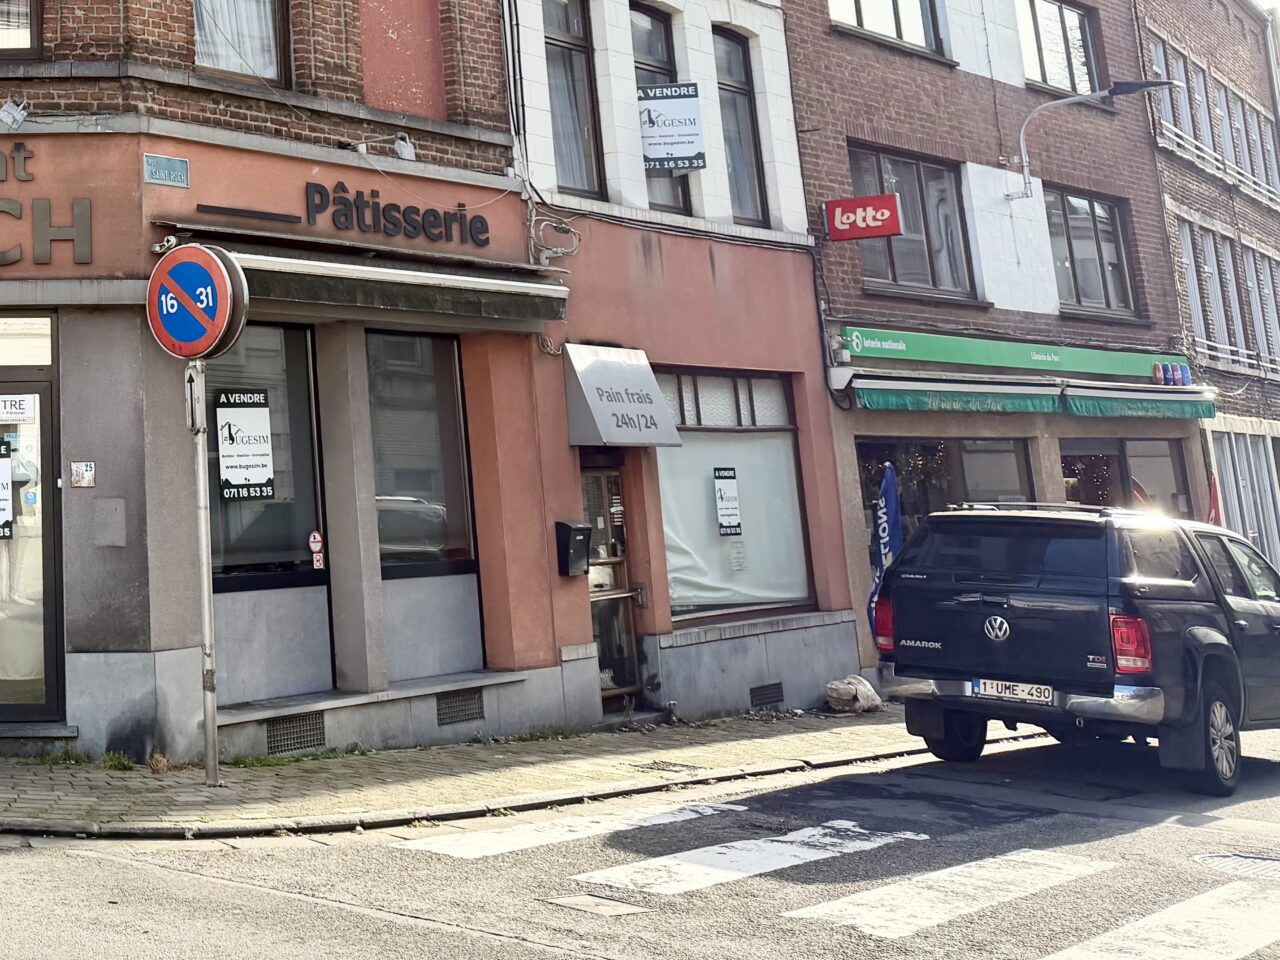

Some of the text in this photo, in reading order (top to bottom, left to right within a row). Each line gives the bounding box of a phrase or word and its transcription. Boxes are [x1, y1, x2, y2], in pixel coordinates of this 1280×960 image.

[646, 86, 696, 97] VENDRE
[644, 159, 704, 169] 071 16 53 35
[305, 180, 491, 248] Pâtisserie
[160, 285, 214, 315] 16 31
[219, 393, 266, 403] A VENDRE
[595, 386, 654, 405] Pain frais
[611, 412, 658, 432] 24h/24
[225, 463, 268, 471] www.bugesim.be
[223, 487, 273, 498] 071 16 53 35
[899, 639, 942, 649] AMAROK
[1087, 654, 1107, 663] TDI
